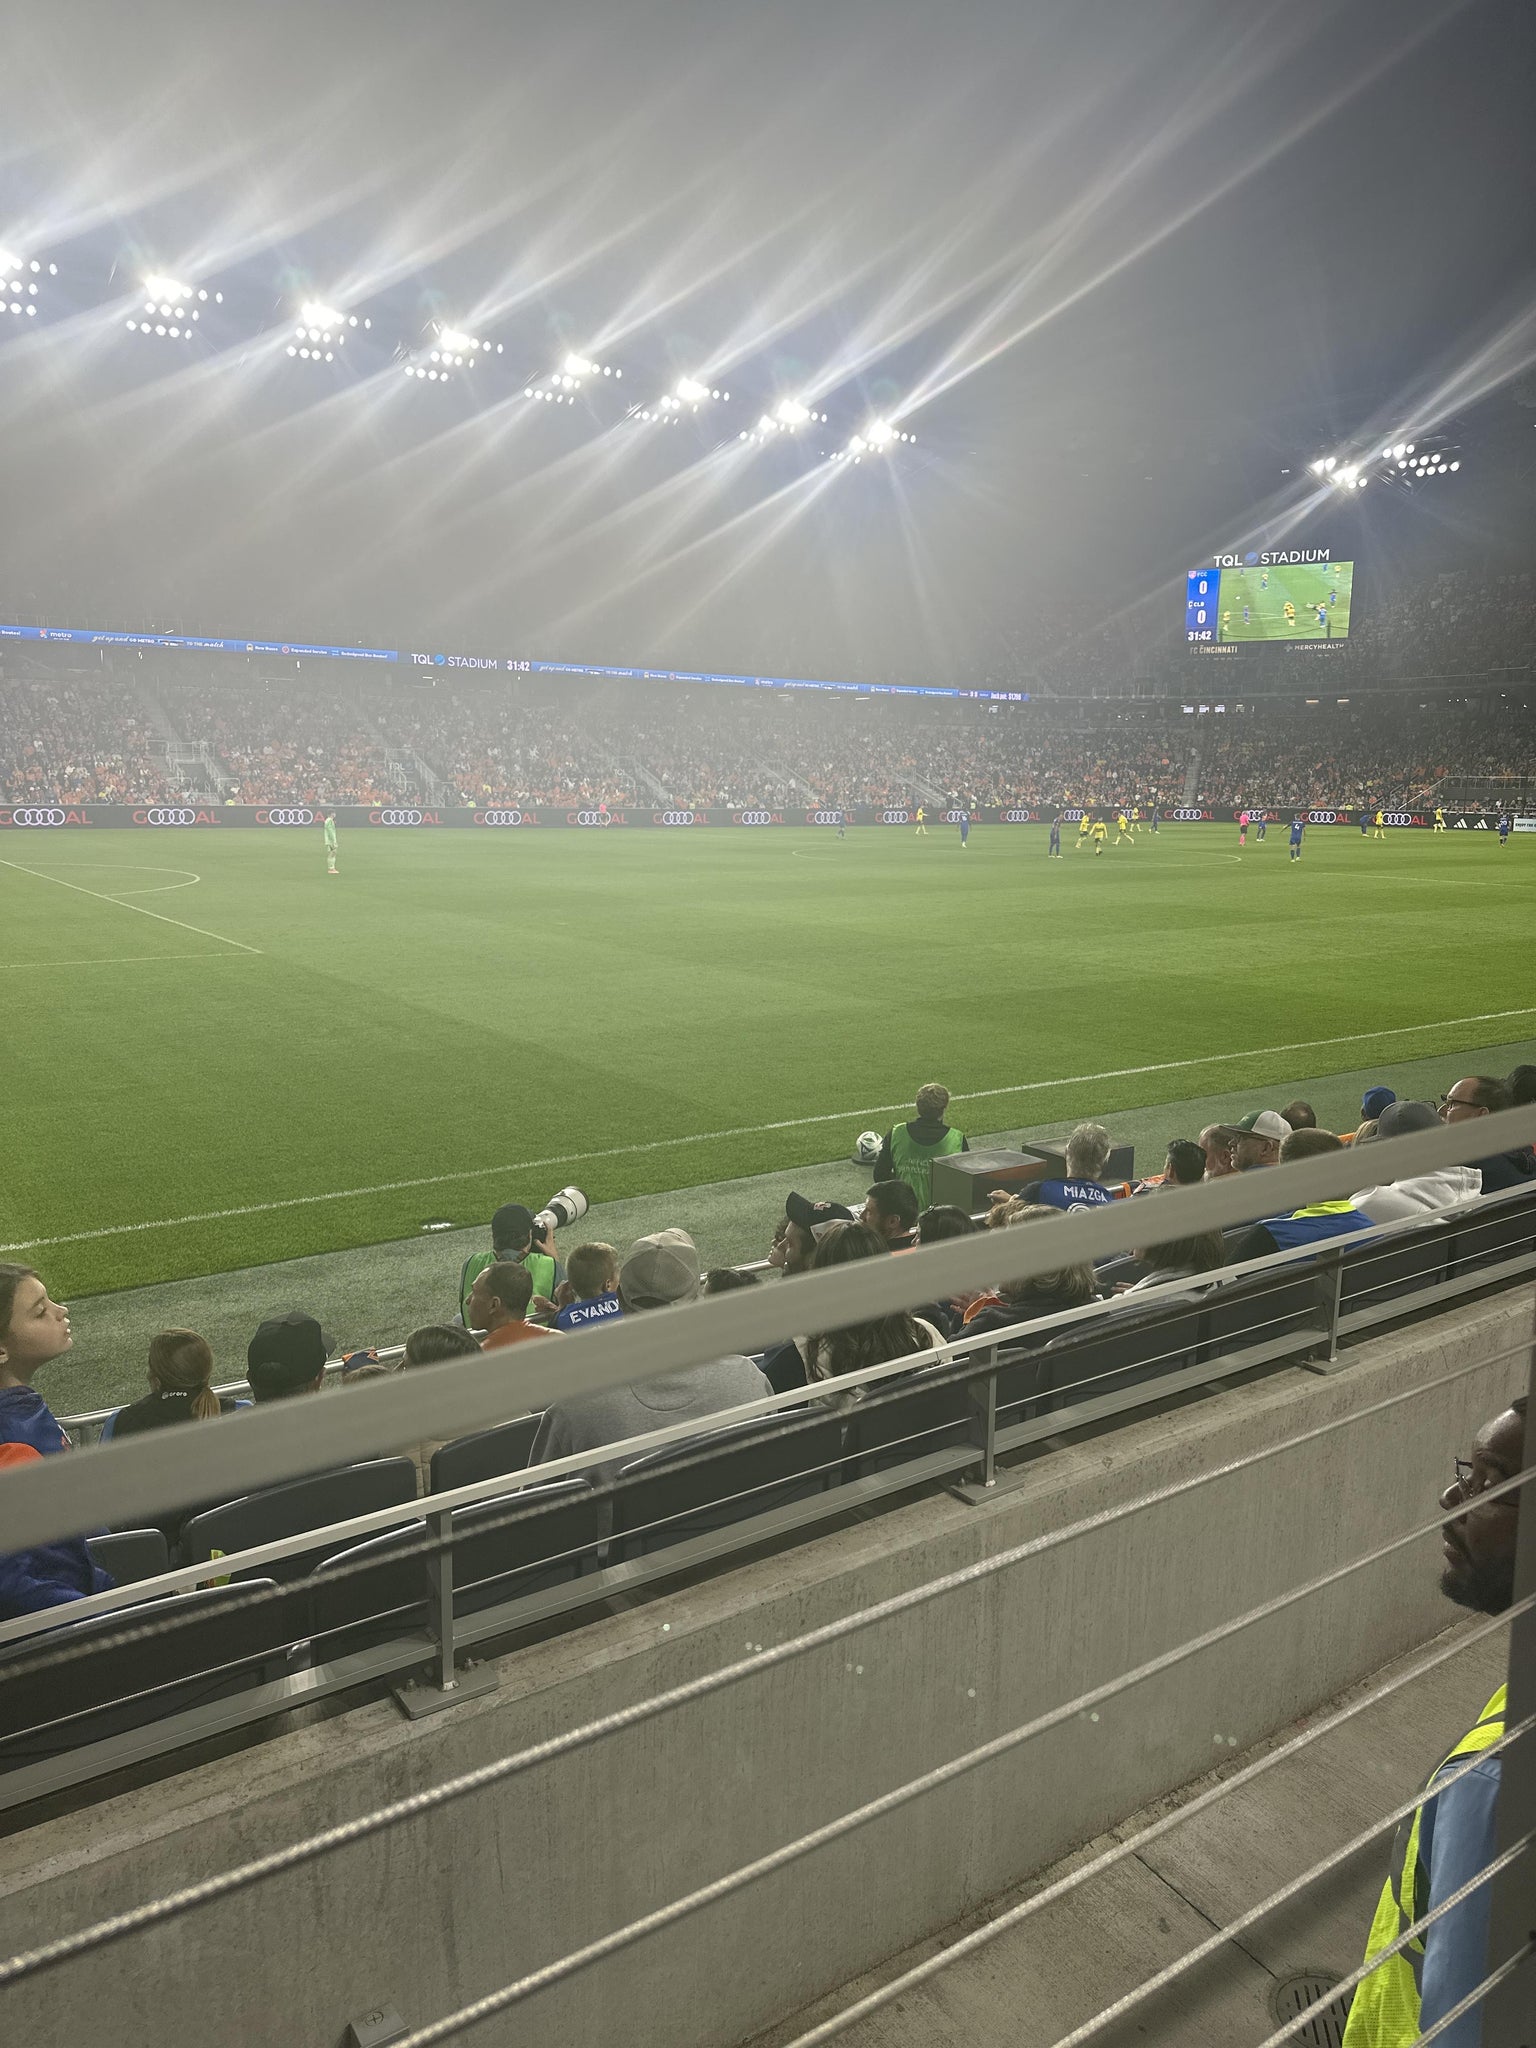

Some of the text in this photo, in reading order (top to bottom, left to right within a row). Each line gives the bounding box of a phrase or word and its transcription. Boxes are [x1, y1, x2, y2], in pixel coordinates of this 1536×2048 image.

[1213, 549, 1330, 567] TQL STADIUM
[1199, 580, 1208, 595] 0
[1197, 609, 1206, 624] 0
[1187, 630, 1212, 641] 31:42
[1199, 645, 1238, 654] CINCINNATI
[411, 653, 530, 671] TQL STADIUM 31:42
[1063, 1185, 1108, 1203] MIAZGA
[569, 1298, 620, 1325] EVAND
